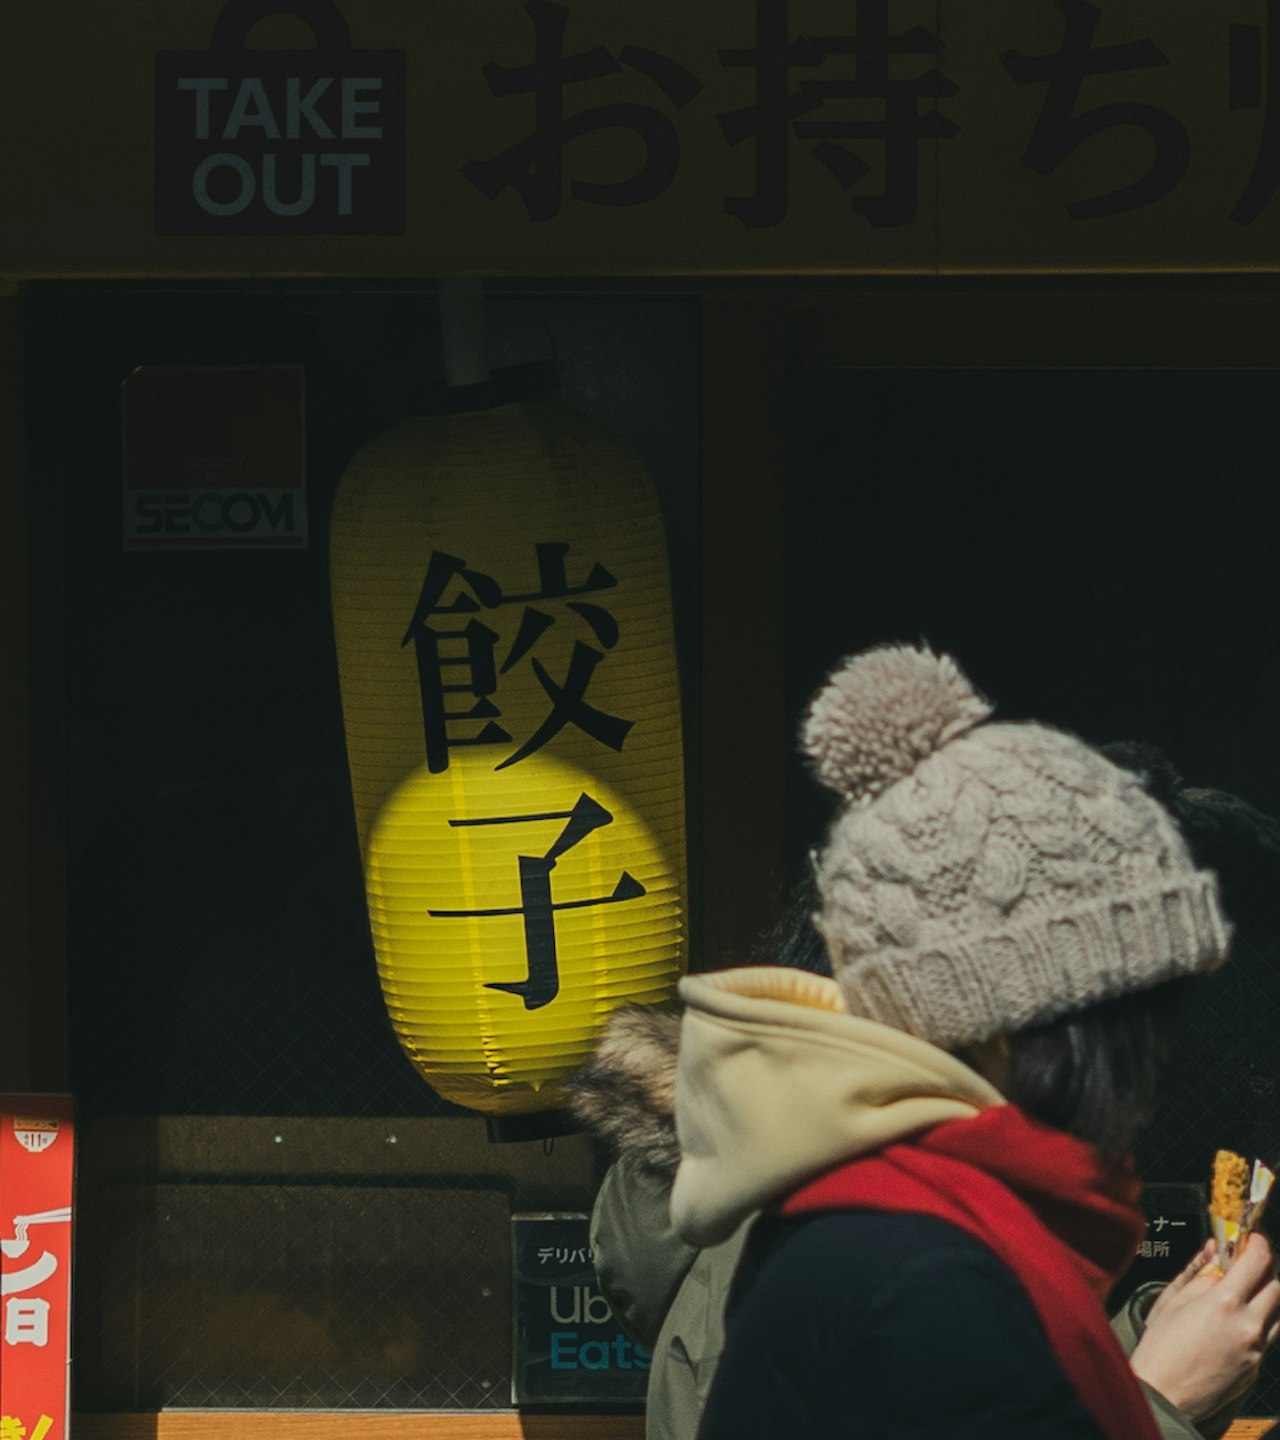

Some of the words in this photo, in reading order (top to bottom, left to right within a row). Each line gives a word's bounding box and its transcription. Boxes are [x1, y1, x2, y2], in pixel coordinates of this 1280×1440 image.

[177, 77, 383, 140] TAKE
[192, 152, 370, 218] OUT
[136, 492, 295, 534] SECOM
[401, 542, 647, 1010] 餃子
[1144, 1215, 1187, 1233] ナー
[550, 1285, 613, 1325] Ub
